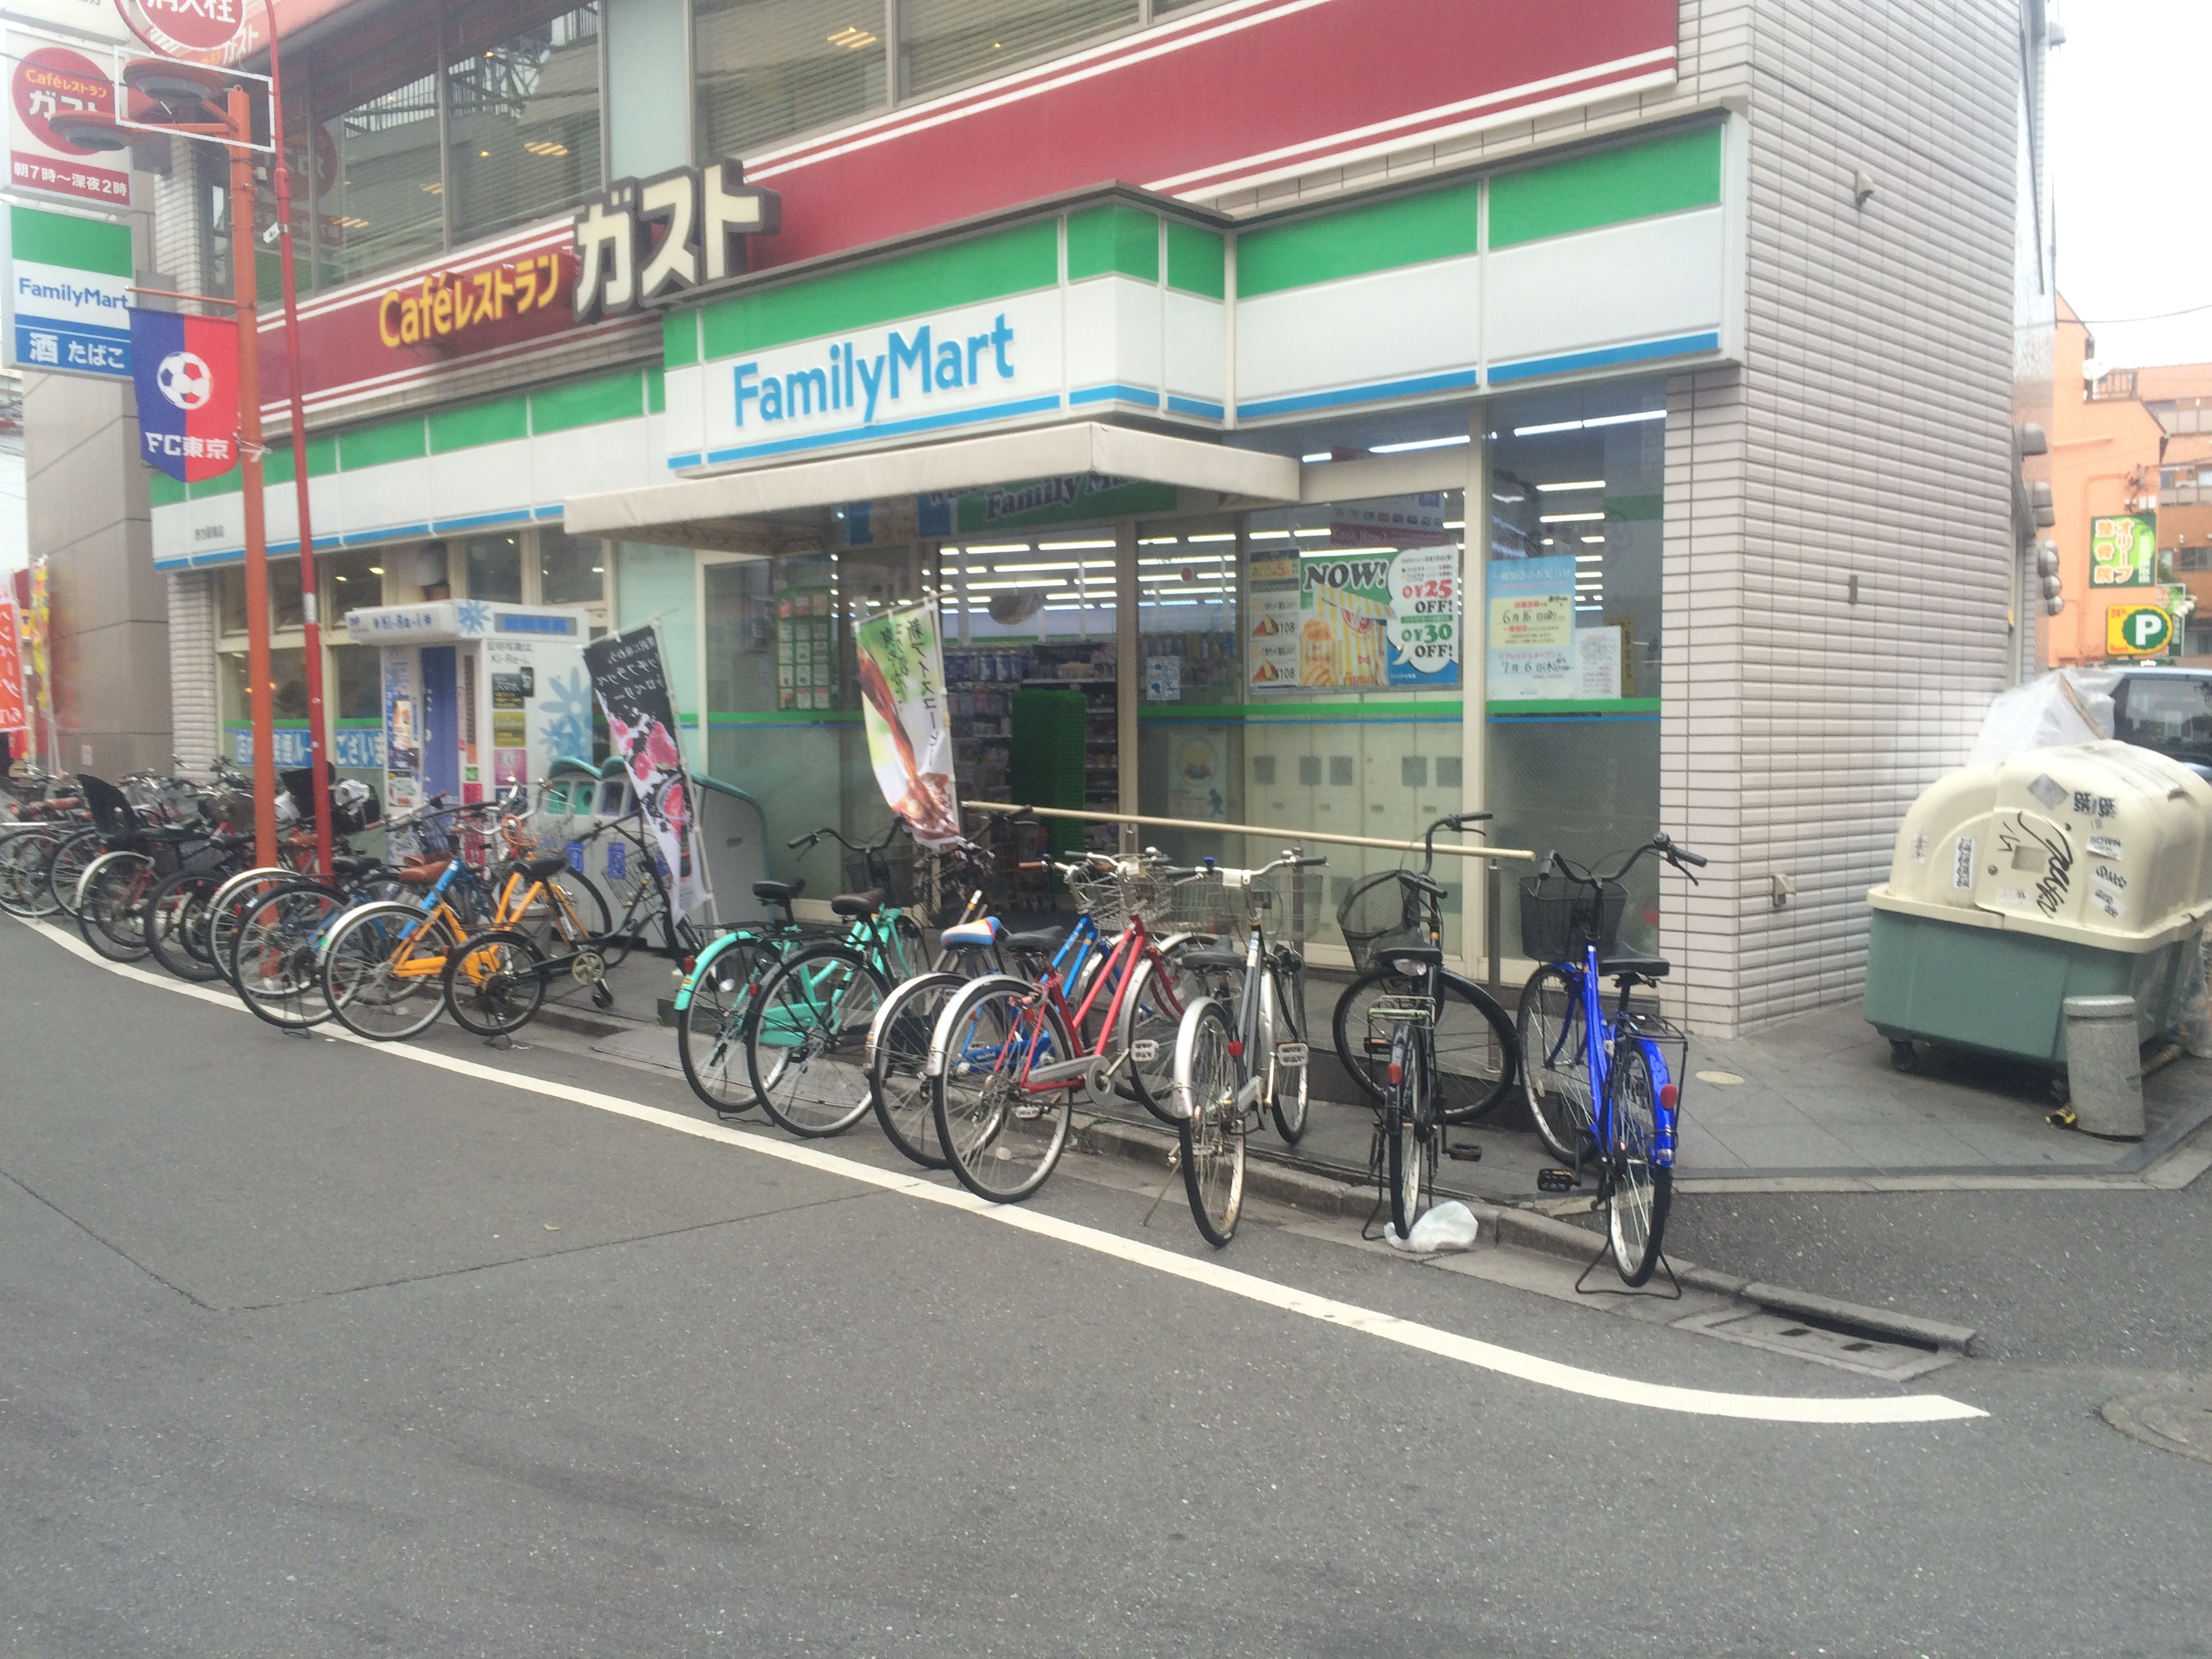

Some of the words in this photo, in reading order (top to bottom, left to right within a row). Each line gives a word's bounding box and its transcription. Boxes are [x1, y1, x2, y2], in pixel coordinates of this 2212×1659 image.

[576, 164, 761, 314] ガスト
[18, 277, 129, 310] FamilyMart
[378, 253, 560, 348] Caféレストラン
[29, 332, 59, 364] 酒
[68, 341, 125, 369] たばこ
[733, 312, 1015, 427] FamilyMart
[144, 431, 230, 460] FC東京
[1303, 560, 1387, 590] NOW!
[1415, 600, 1453, 613] OFF!
[2135, 614, 2163, 646] P
[1415, 644, 1453, 658] OFF!
